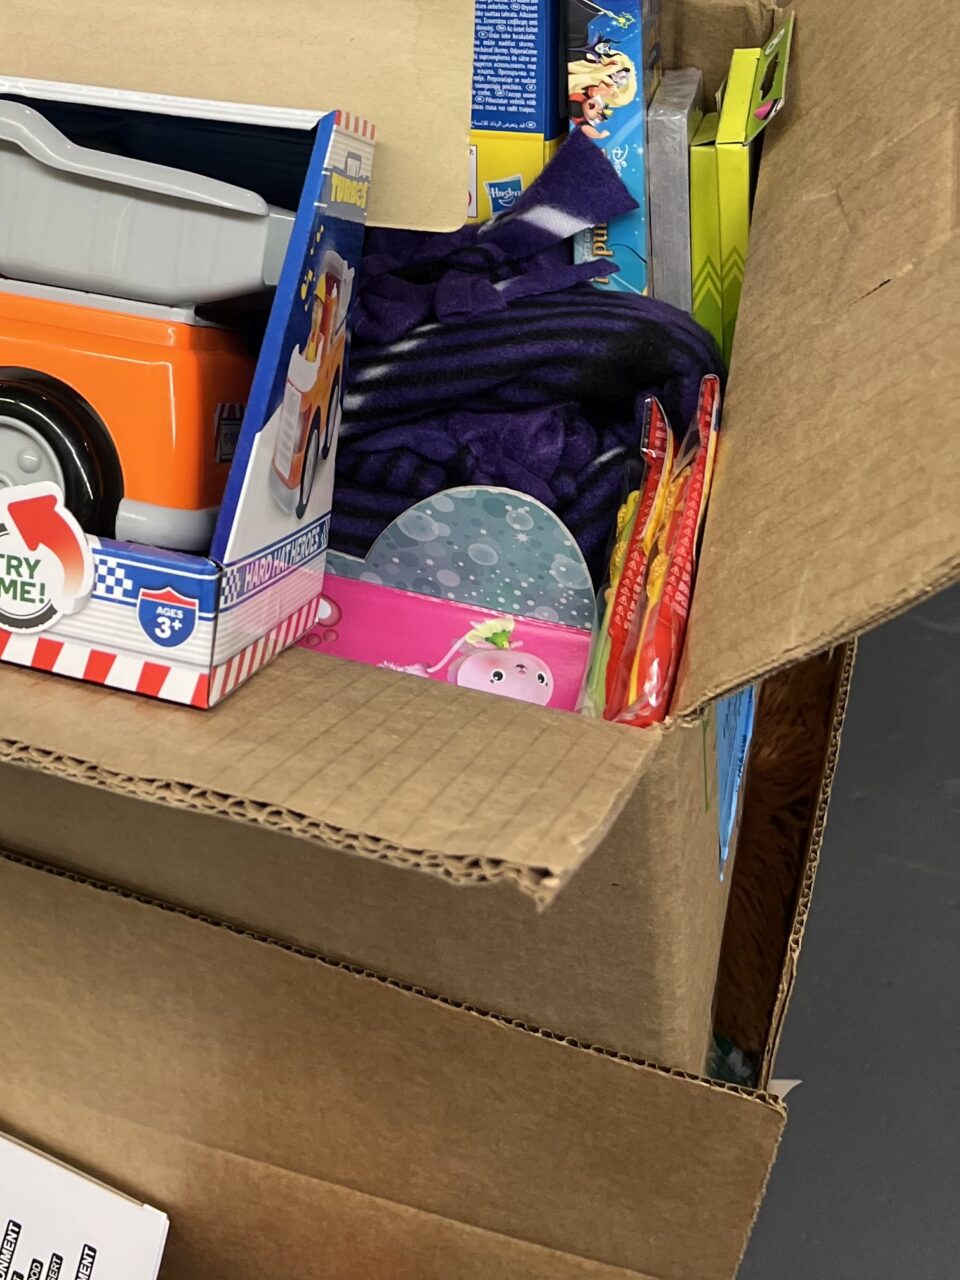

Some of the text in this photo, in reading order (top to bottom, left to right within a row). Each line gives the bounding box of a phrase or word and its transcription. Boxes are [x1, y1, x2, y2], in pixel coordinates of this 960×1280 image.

[244, 554, 274, 593] HARD
[290, 526, 320, 566] HEROES
[155, 605, 184, 619] AGES
[154, 616, 183, 639] 3+
